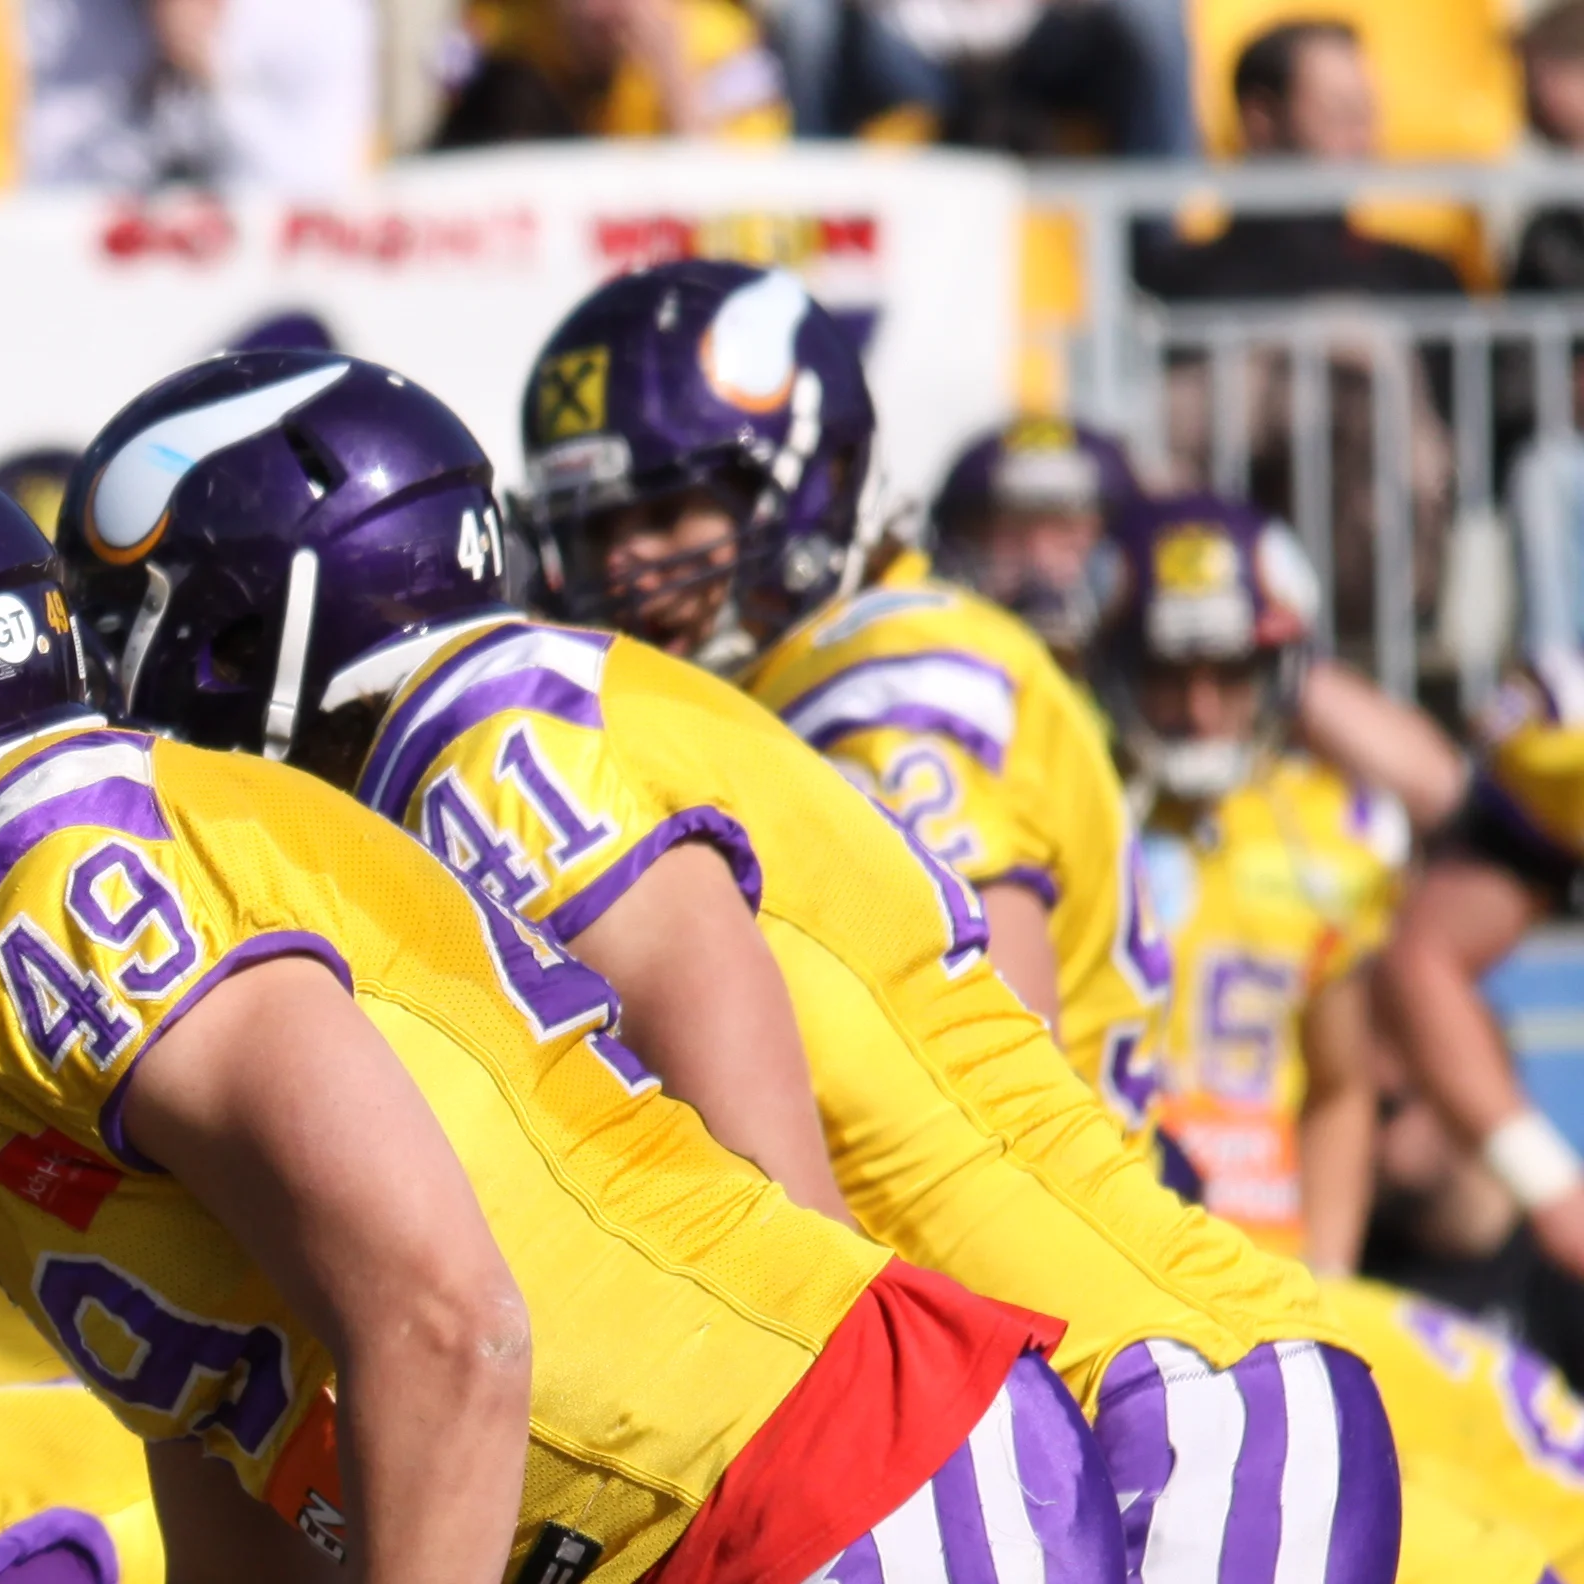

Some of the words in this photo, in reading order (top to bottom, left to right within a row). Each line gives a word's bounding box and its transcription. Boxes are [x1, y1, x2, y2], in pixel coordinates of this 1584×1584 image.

[458, 509, 504, 582] 41
[45, 590, 71, 635] 49
[422, 719, 620, 916] 41
